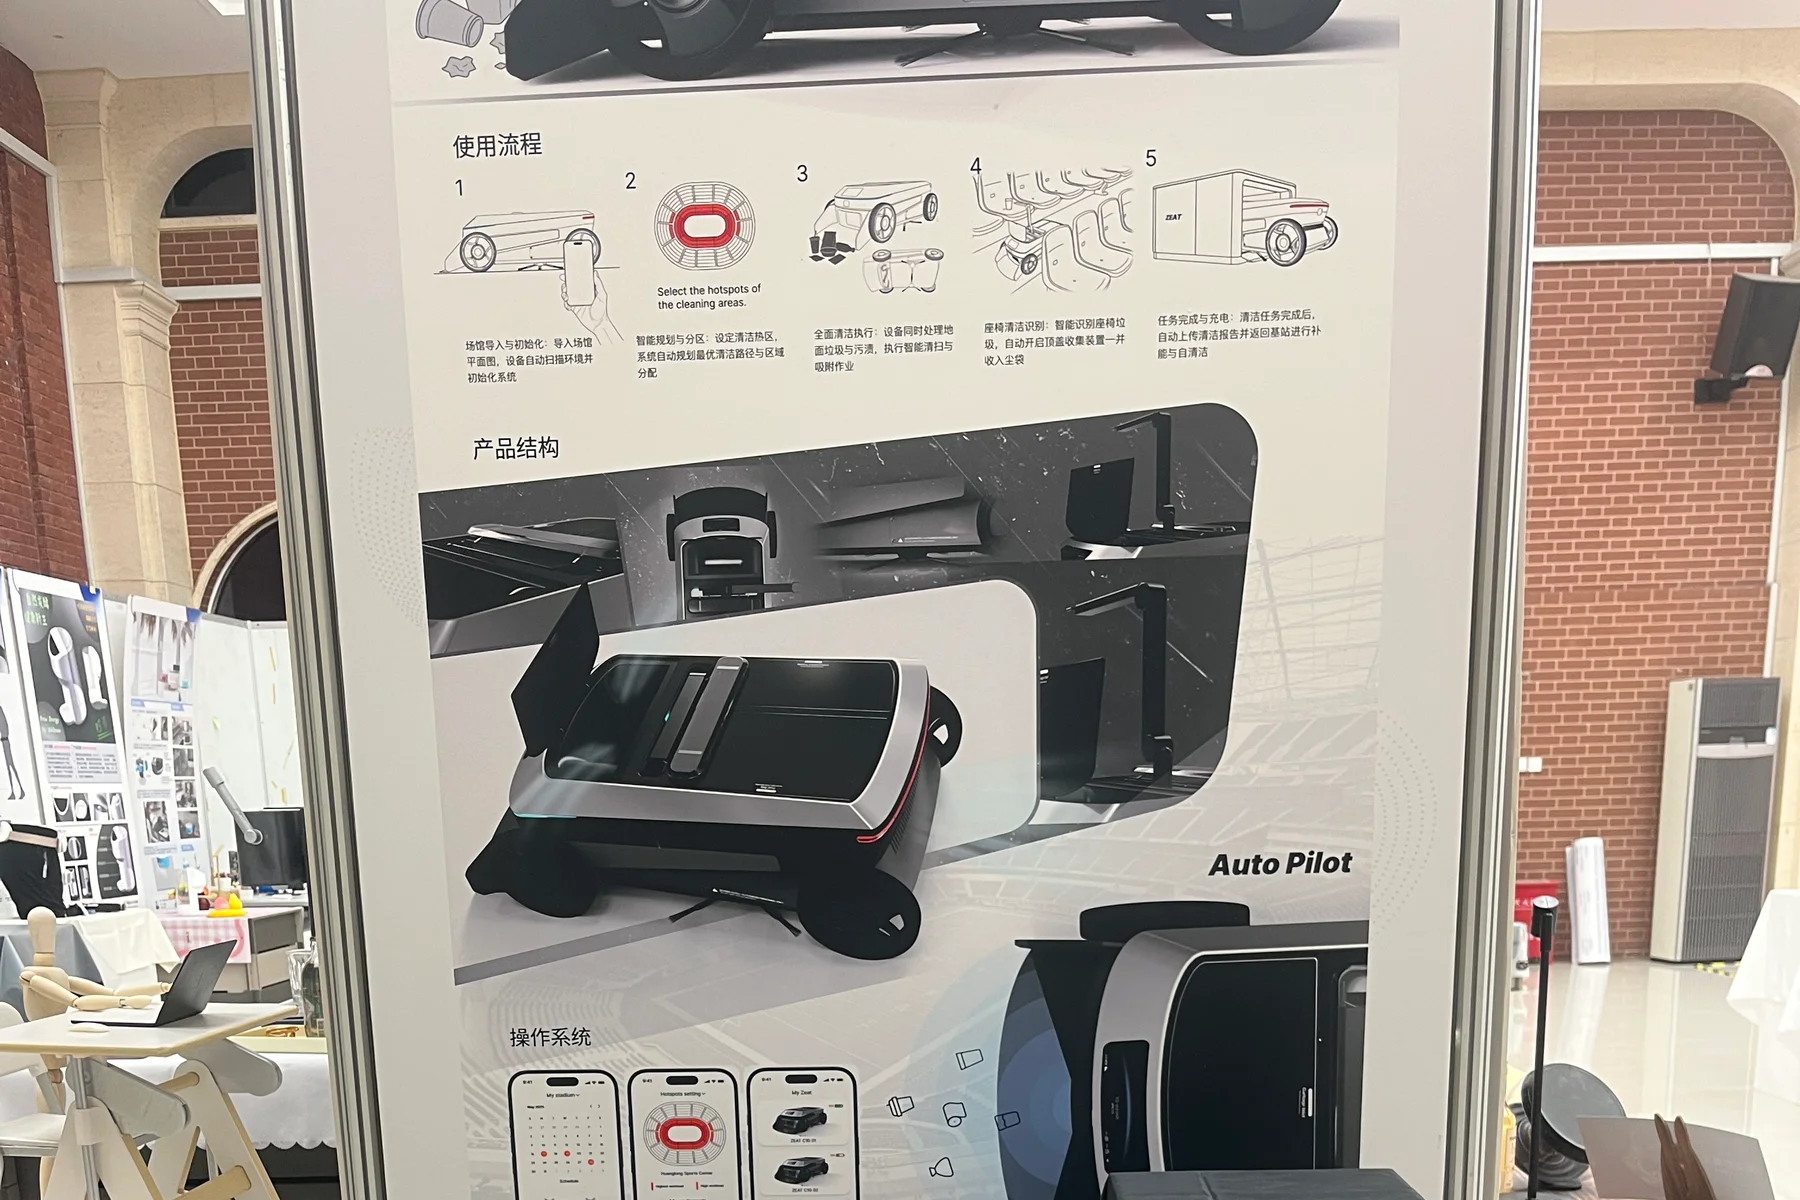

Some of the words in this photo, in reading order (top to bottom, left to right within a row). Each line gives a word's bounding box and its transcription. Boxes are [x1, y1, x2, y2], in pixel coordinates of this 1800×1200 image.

[453, 132, 542, 159] 使用流程
[970, 157, 981, 175] 4
[1145, 149, 1157, 168] 5
[625, 172, 637, 190] 2
[796, 164, 809, 182] 3
[455, 179, 463, 196] 1
[657, 287, 687, 297] Select
[689, 286, 705, 296] the
[707, 285, 749, 296] hotspots
[751, 283, 761, 293] of
[658, 300, 674, 309] the
[676, 299, 716, 310] cleaning
[718, 299, 747, 308] areas.
[637, 347, 785, 362] 系统自动规划最优清洁路径与区域
[984, 354, 1025, 366] 收入尘袋
[1158, 347, 1208, 359] 能与自清洁
[638, 368, 658, 379] 分配
[814, 361, 854, 372] 吸附作业
[467, 371, 517, 383] 初始化系统
[473, 435, 560, 461] 产品结构
[1208, 853, 1280, 876] Auto
[1285, 851, 1353, 874] Pilot
[510, 1027, 592, 1047] 操作系统
